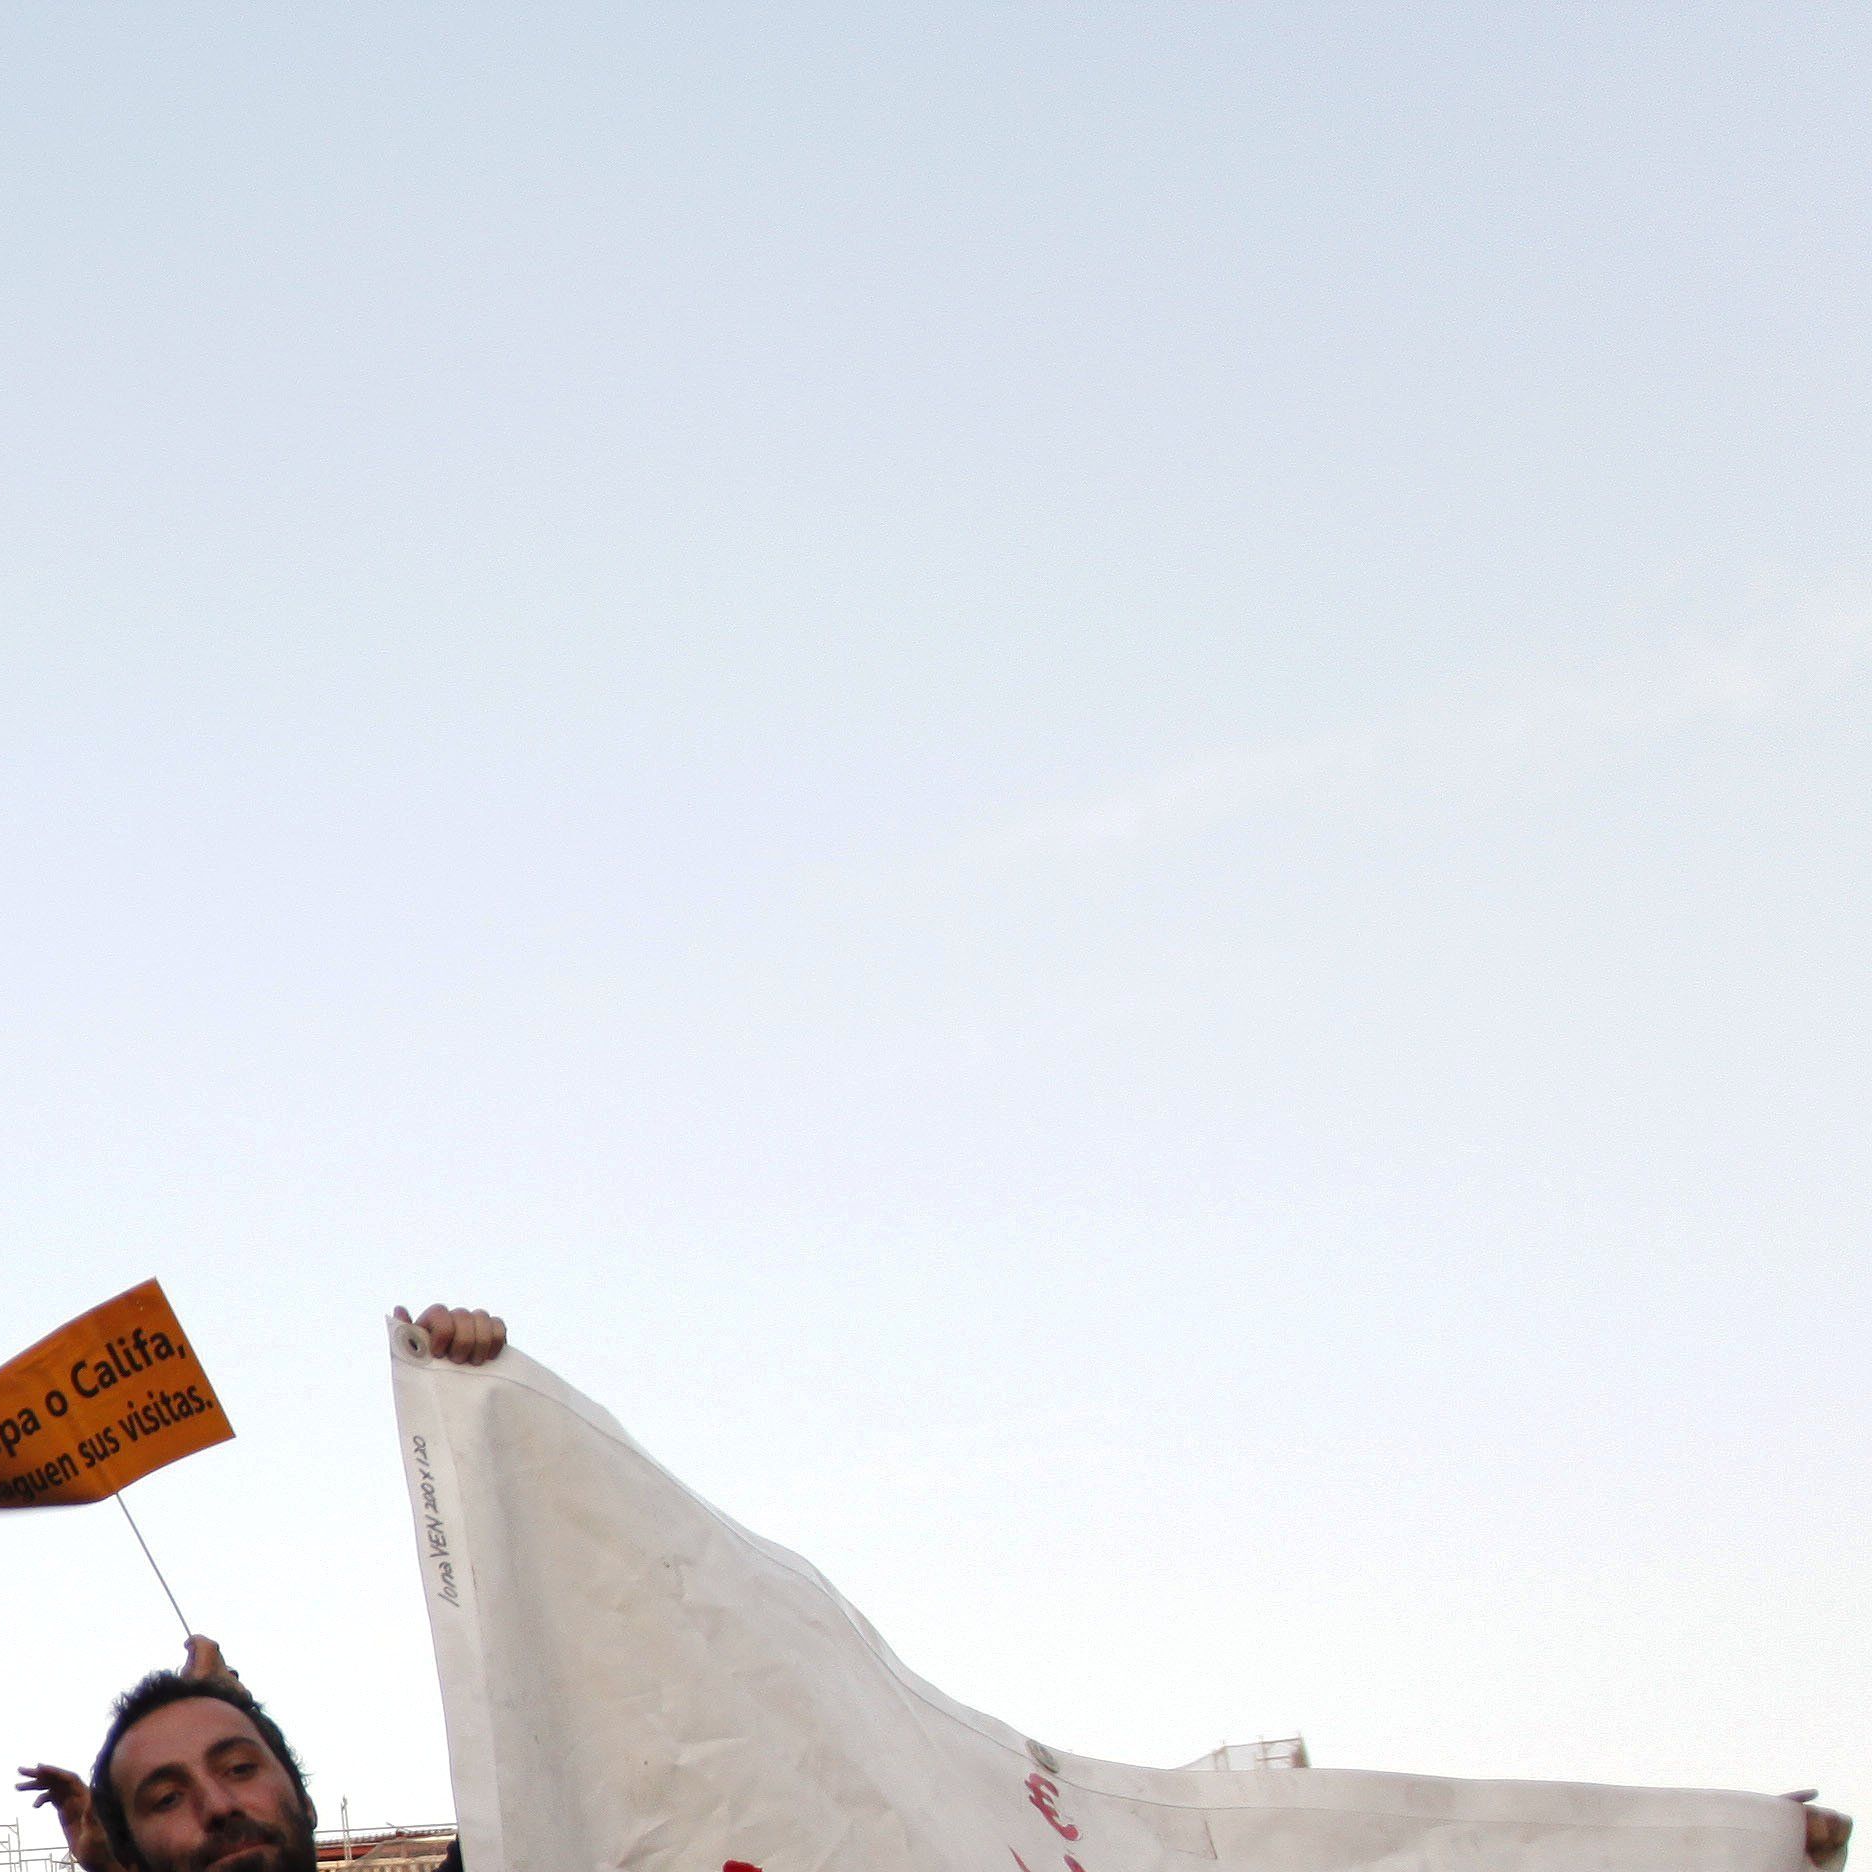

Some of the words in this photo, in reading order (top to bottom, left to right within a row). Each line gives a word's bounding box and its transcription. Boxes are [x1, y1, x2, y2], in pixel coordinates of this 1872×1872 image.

[44, 1389, 69, 1418] o
[69, 1327, 187, 1399] Califa,
[76, 1424, 121, 1469] sus
[428, 1515, 451, 1560] VEN
